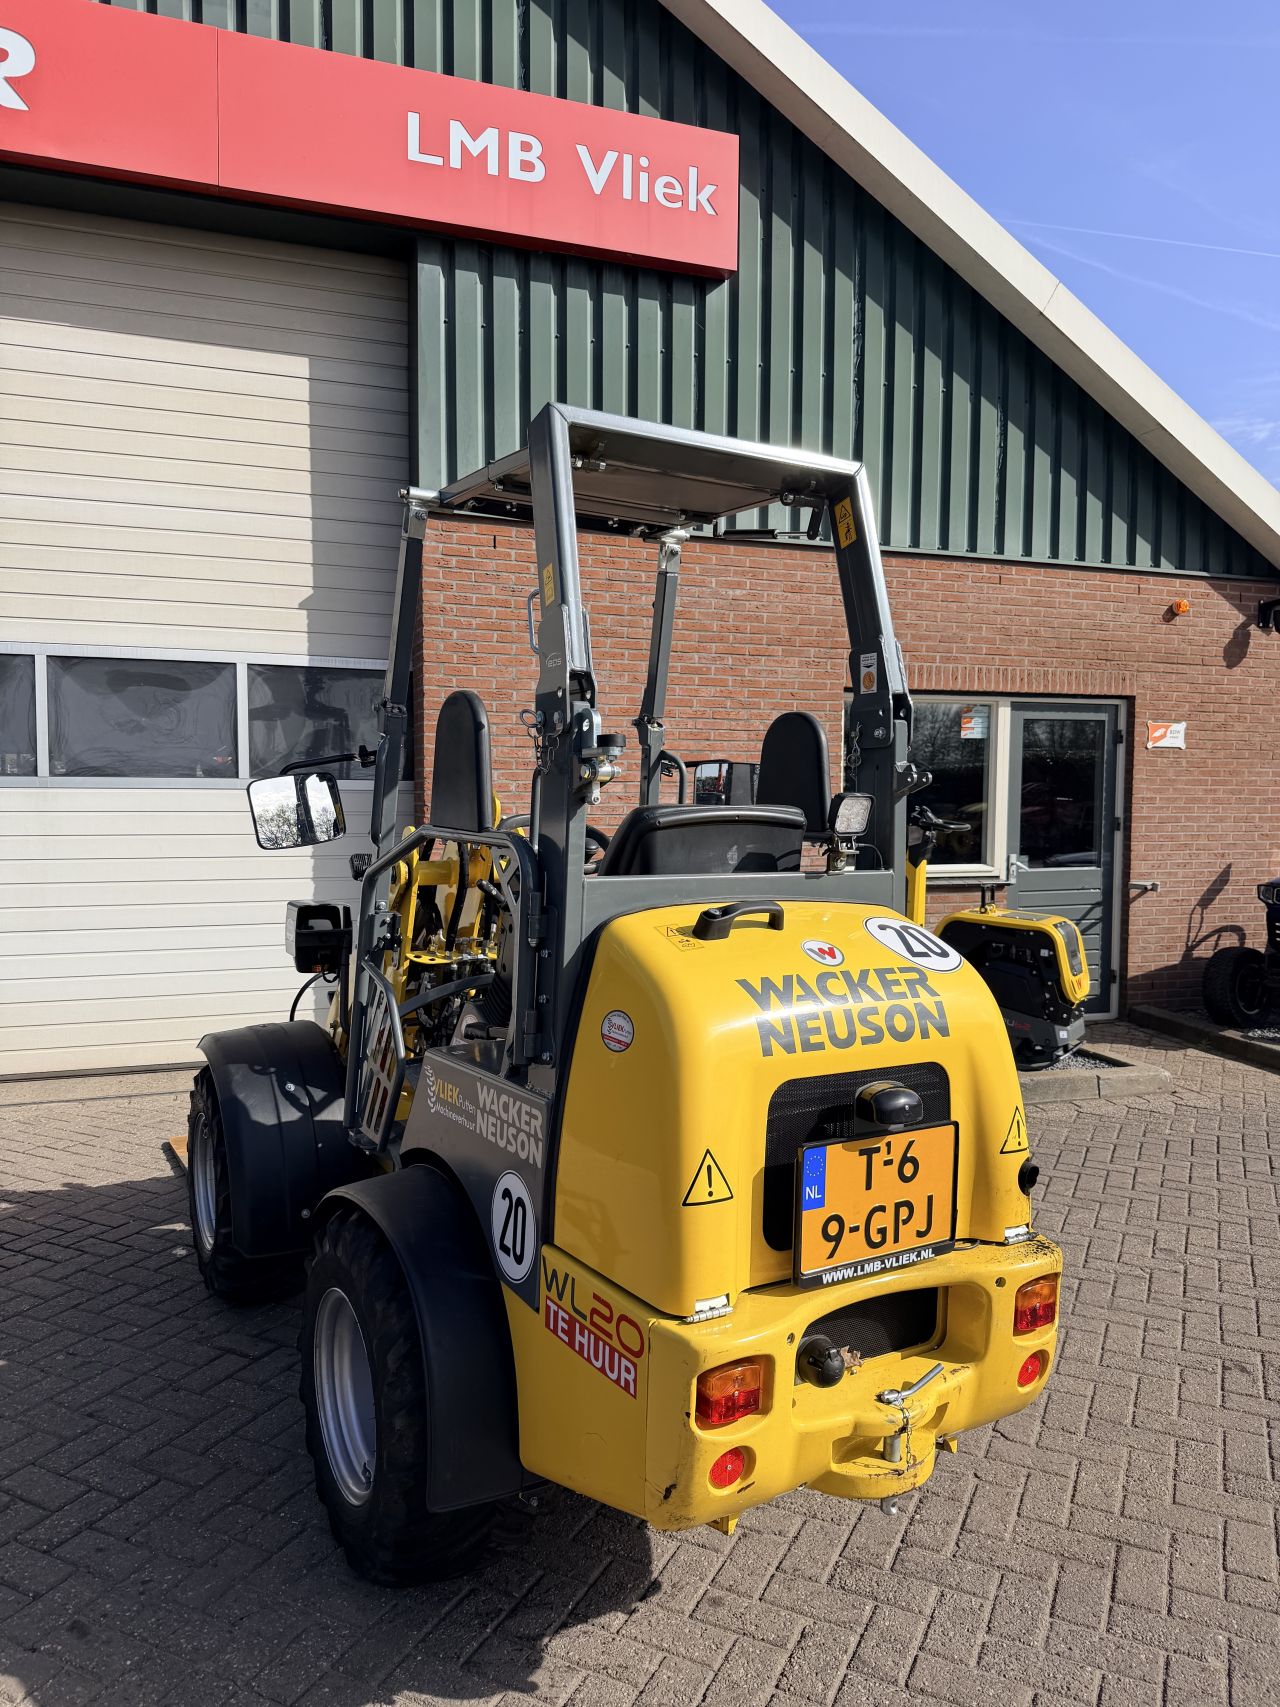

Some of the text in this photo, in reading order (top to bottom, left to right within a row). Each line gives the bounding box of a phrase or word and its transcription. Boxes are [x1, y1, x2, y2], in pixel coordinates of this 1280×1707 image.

[407, 110, 719, 216] LMB Vliek
[877, 923, 950, 959] 20
[735, 966, 941, 1013] WACKER
[753, 1000, 950, 1058] NEUSON
[435, 1079, 460, 1107] VLIEK
[477, 1082, 543, 1139] WACKER
[476, 1109, 543, 1169] NEUSON
[805, 1185, 822, 1201] NL
[499, 1187, 527, 1266] 20
[821, 1193, 934, 1260] 9-GPJ
[822, 1248, 935, 1285] WWW.LMB-VLIEK.NL
[542, 1255, 645, 1359] WL20
[546, 1299, 636, 1396] TE HUUR
